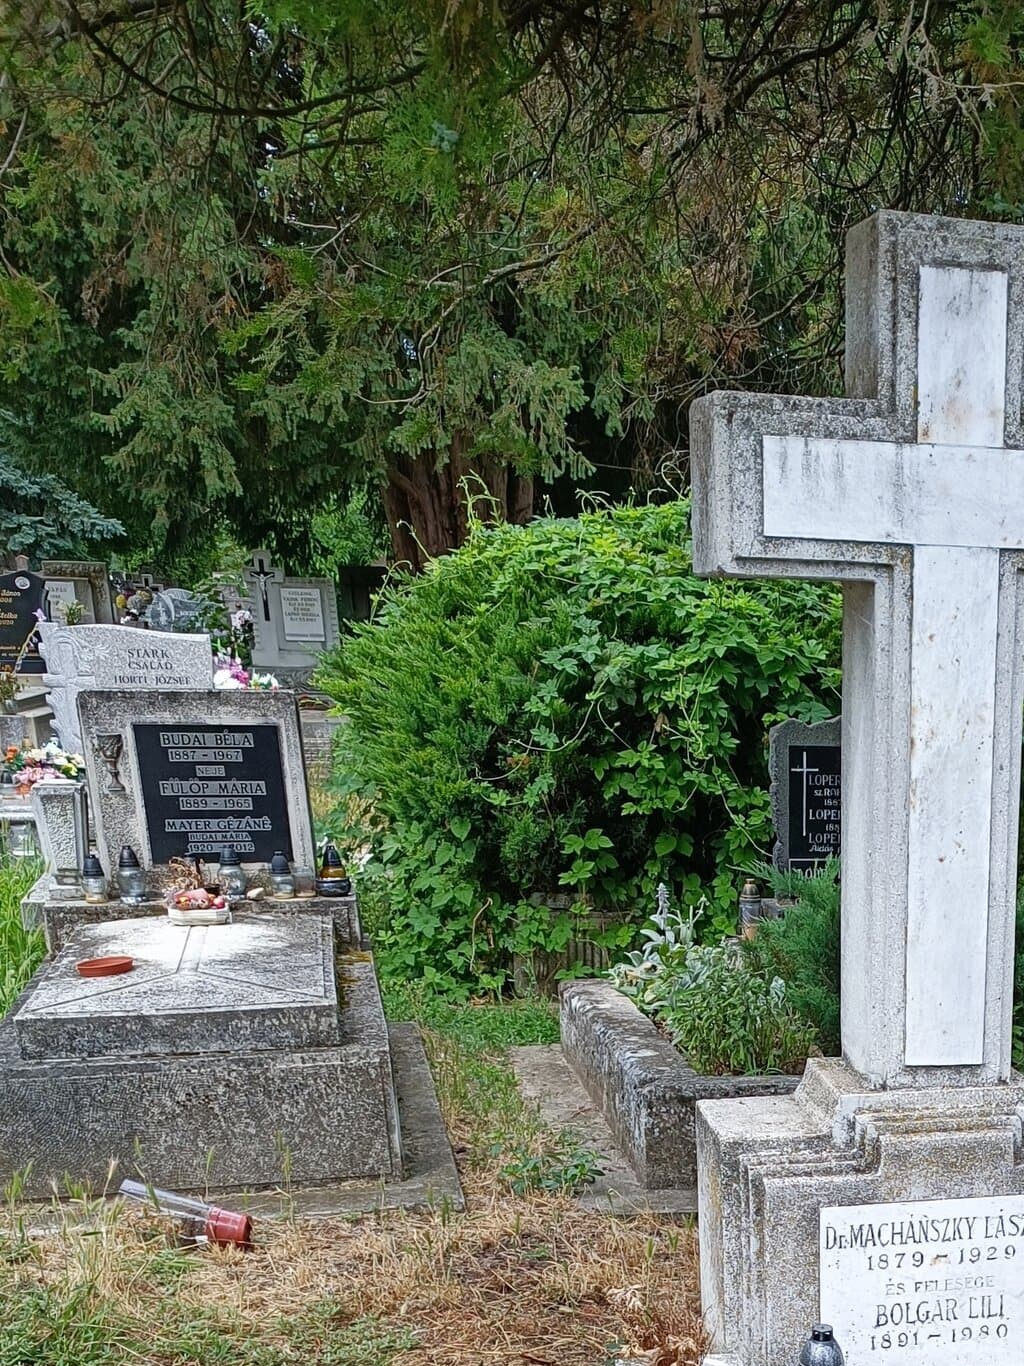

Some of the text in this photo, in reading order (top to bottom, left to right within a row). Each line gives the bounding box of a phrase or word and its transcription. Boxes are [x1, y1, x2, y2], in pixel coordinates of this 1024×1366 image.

[127, 649, 170, 659] STARK
[161, 729, 253, 745] BUDAI BÉLA
[169, 751, 196, 760] 1887
[214, 751, 240, 760] 1967
[160, 777, 265, 794] FÜLÖP MÁRIA
[181, 799, 207, 808] 1889
[165, 820, 211, 831] MAYER
[229, 843, 254, 852] 012
[867, 1251, 924, 1271] 1879
[958, 1244, 1016, 1264] 1929
[870, 1332, 919, 1350] 1891
[951, 1323, 1008, 1343] 1980
